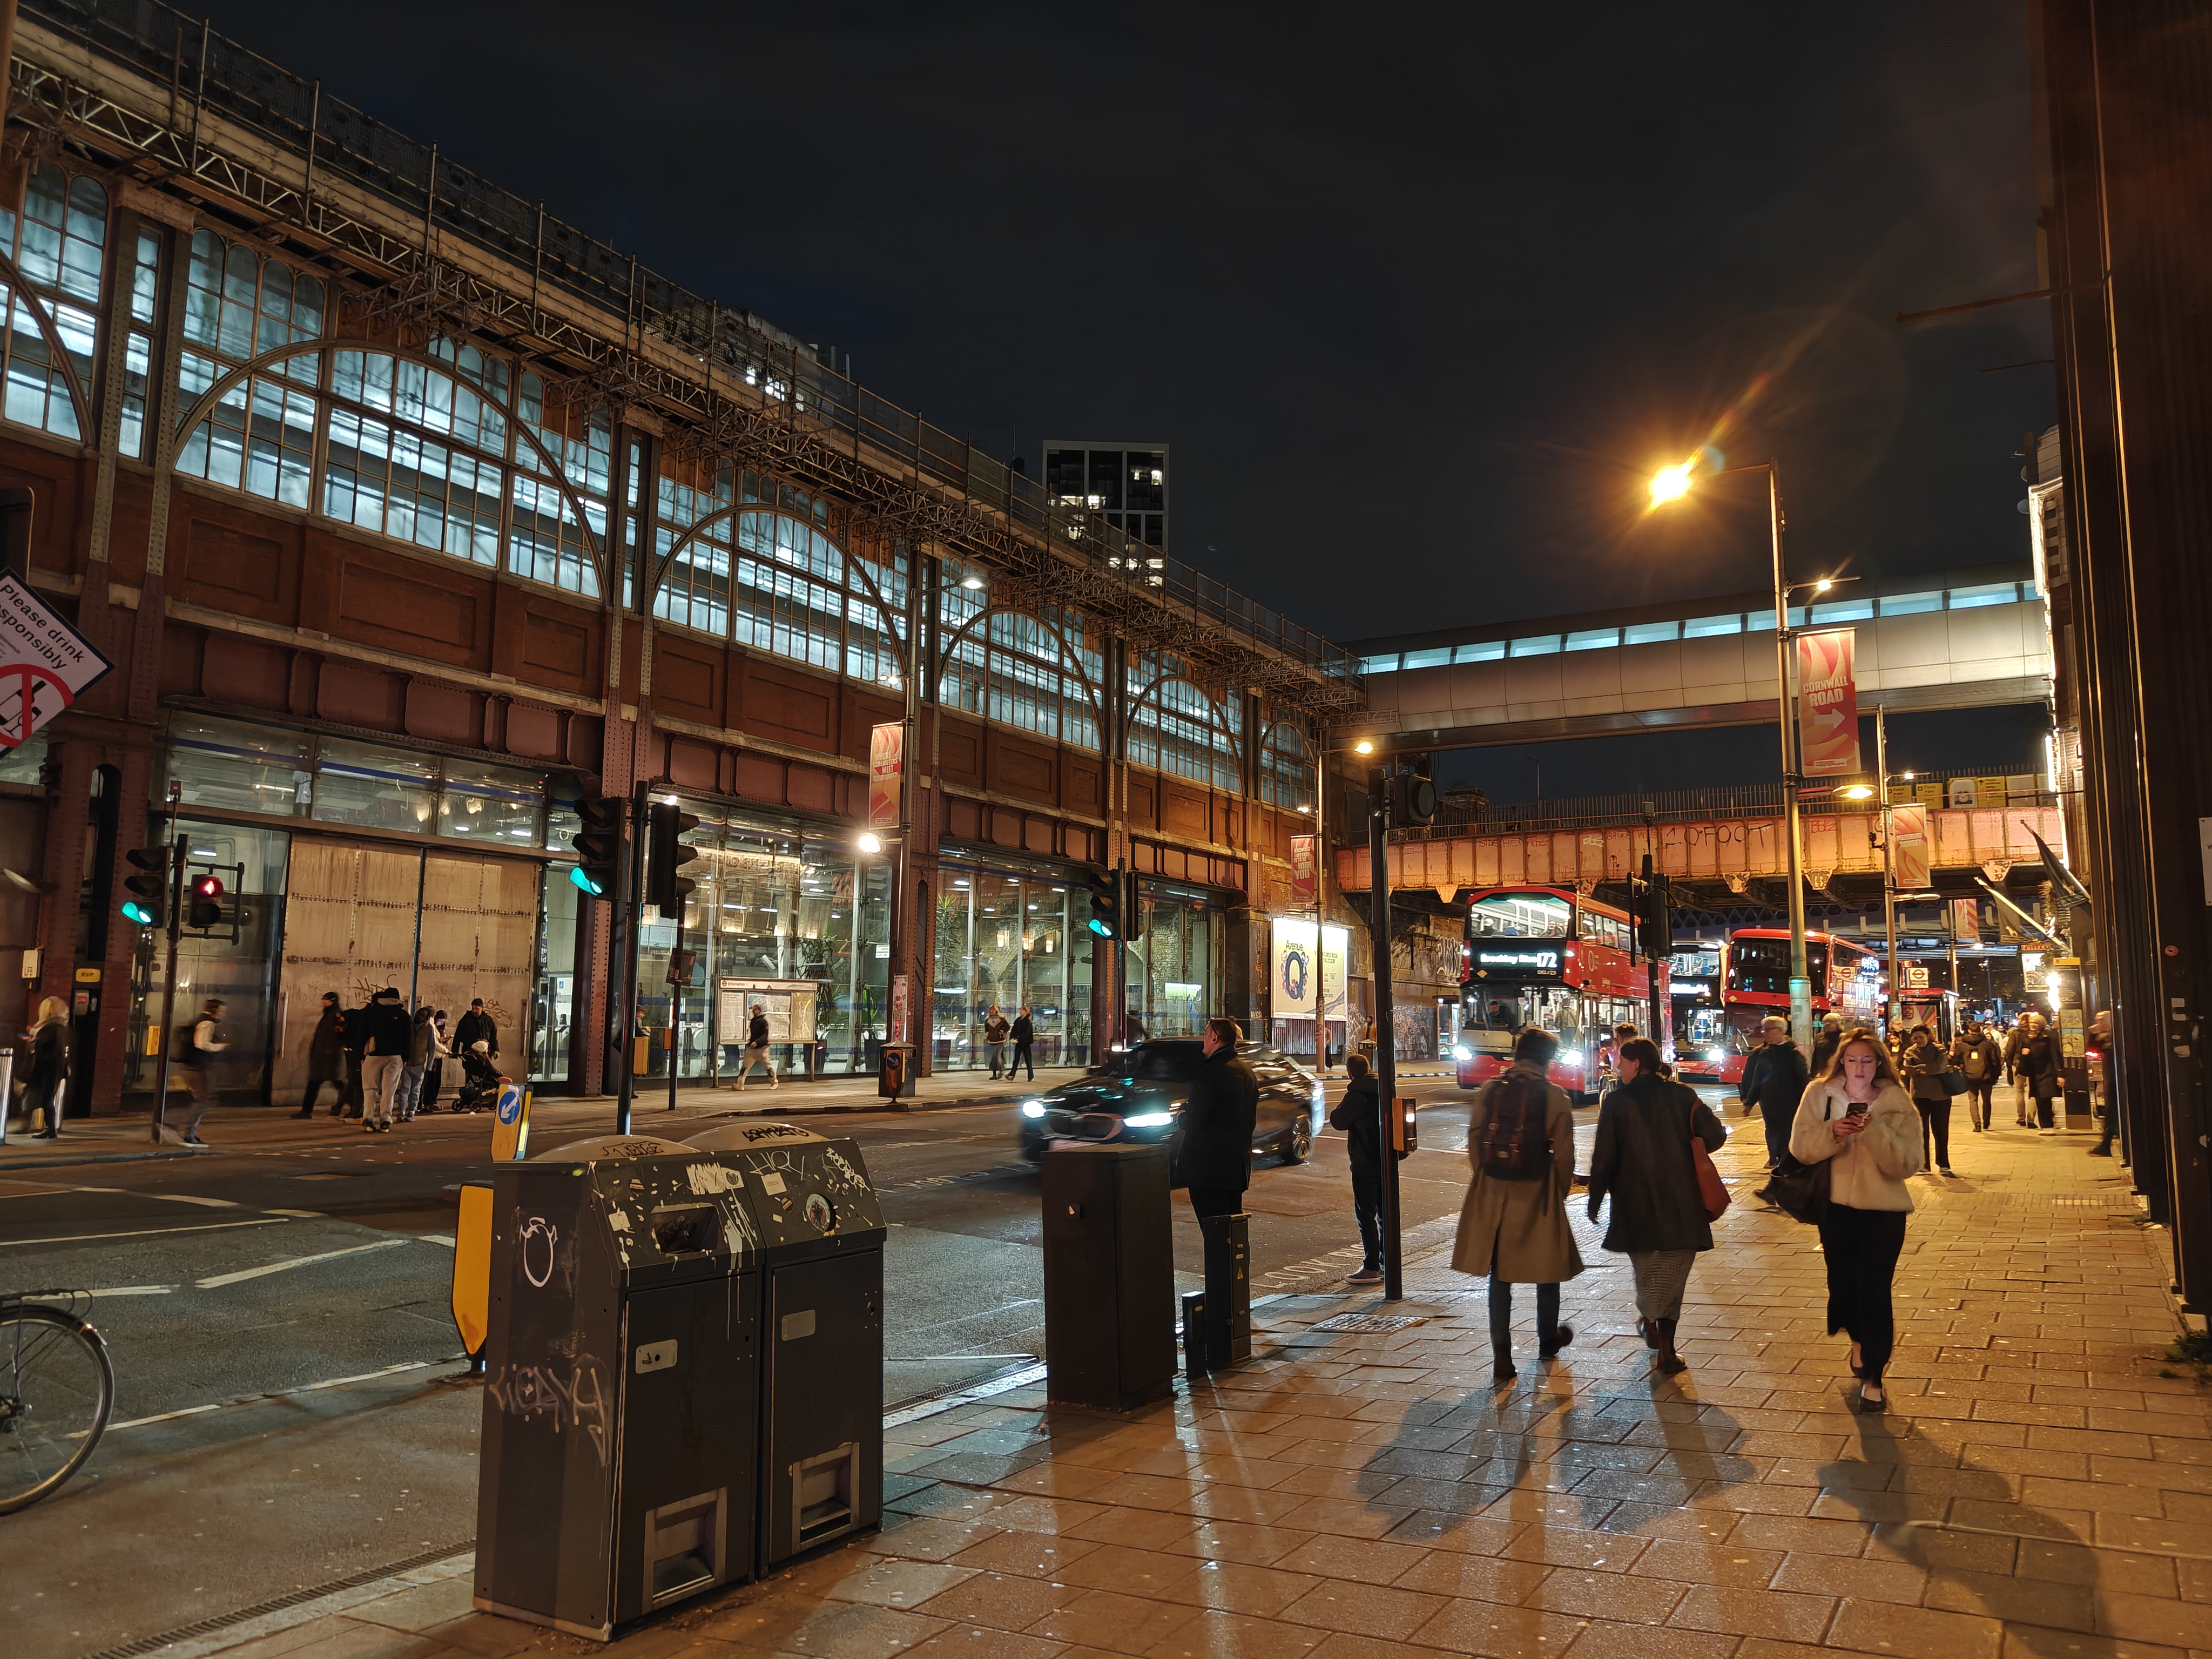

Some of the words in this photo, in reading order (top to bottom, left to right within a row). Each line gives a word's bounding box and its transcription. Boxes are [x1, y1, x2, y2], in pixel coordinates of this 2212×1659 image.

[0, 584, 47, 629] Please
[48, 629, 85, 664] drink
[0, 604, 68, 670] sponsibly
[1803, 676, 1849, 693] CORNWALL
[1808, 688, 1844, 707] ROAD
[875, 752, 892, 761] WHERE
[882, 765, 893, 774] MEET
[1295, 869, 1310, 880] YOU
[1536, 952, 1557, 968] 172
